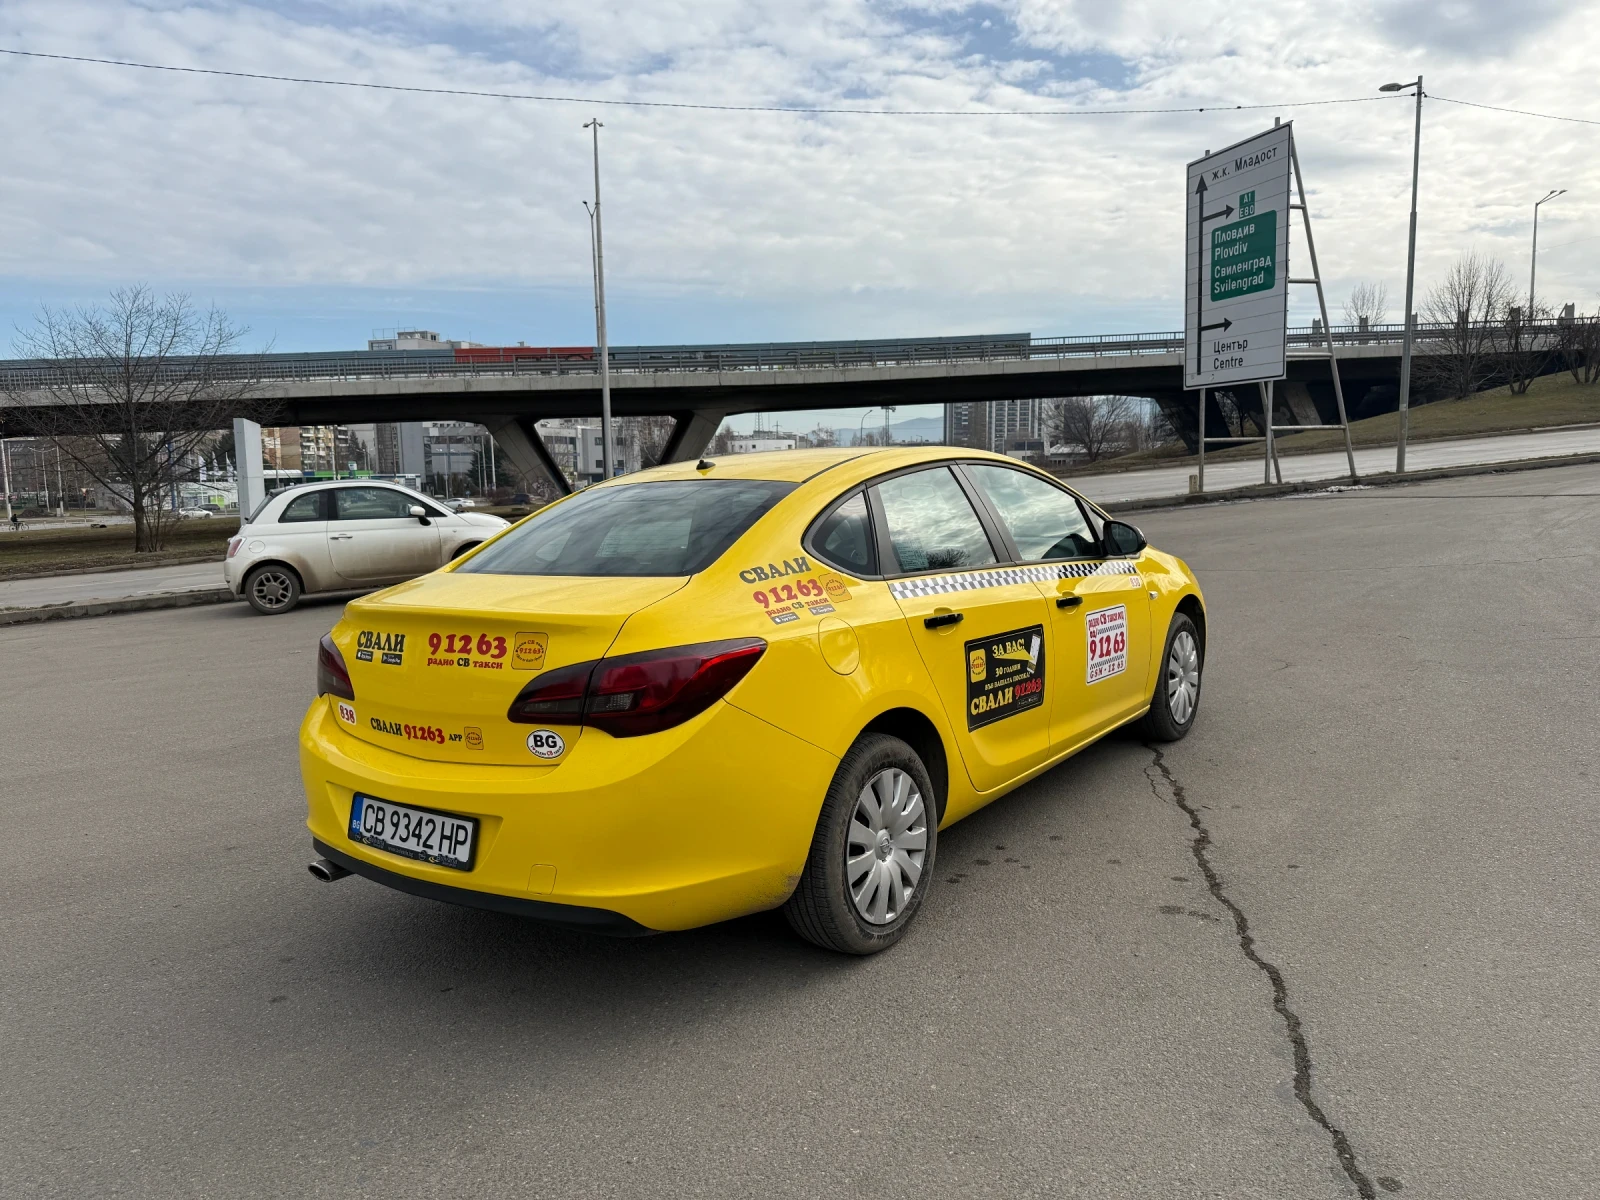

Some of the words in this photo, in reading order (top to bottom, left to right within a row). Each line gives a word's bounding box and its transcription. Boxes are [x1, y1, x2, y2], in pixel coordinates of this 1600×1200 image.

[1212, 167, 1230, 181] ж.к.
[1234, 147, 1278, 172] Младост
[1243, 193, 1252, 203] A1
[1240, 205, 1255, 218] E80
[1214, 223, 1255, 244] Пловдив
[1214, 242, 1248, 261] Plovdiv
[1214, 255, 1272, 279] Свиленград
[1214, 271, 1264, 294] Svilengrad
[1213, 338, 1248, 355] Център
[1213, 356, 1244, 370] Centre
[739, 556, 812, 584] СВАЛИ
[752, 579, 824, 609] 91263
[357, 630, 406, 653] СВАЛИ
[428, 632, 508, 660] 91263
[992, 644, 1004, 658] ЗА
[427, 657, 455, 666] радио
[473, 660, 503, 669] такси
[970, 686, 1013, 716] СВАЛИ
[1014, 677, 1042, 700] 91263
[339, 704, 356, 724] 838
[370, 717, 403, 737] СВАЛИ
[404, 724, 446, 744] 91263
[533, 734, 558, 748] BG
[352, 819, 360, 829] BG
